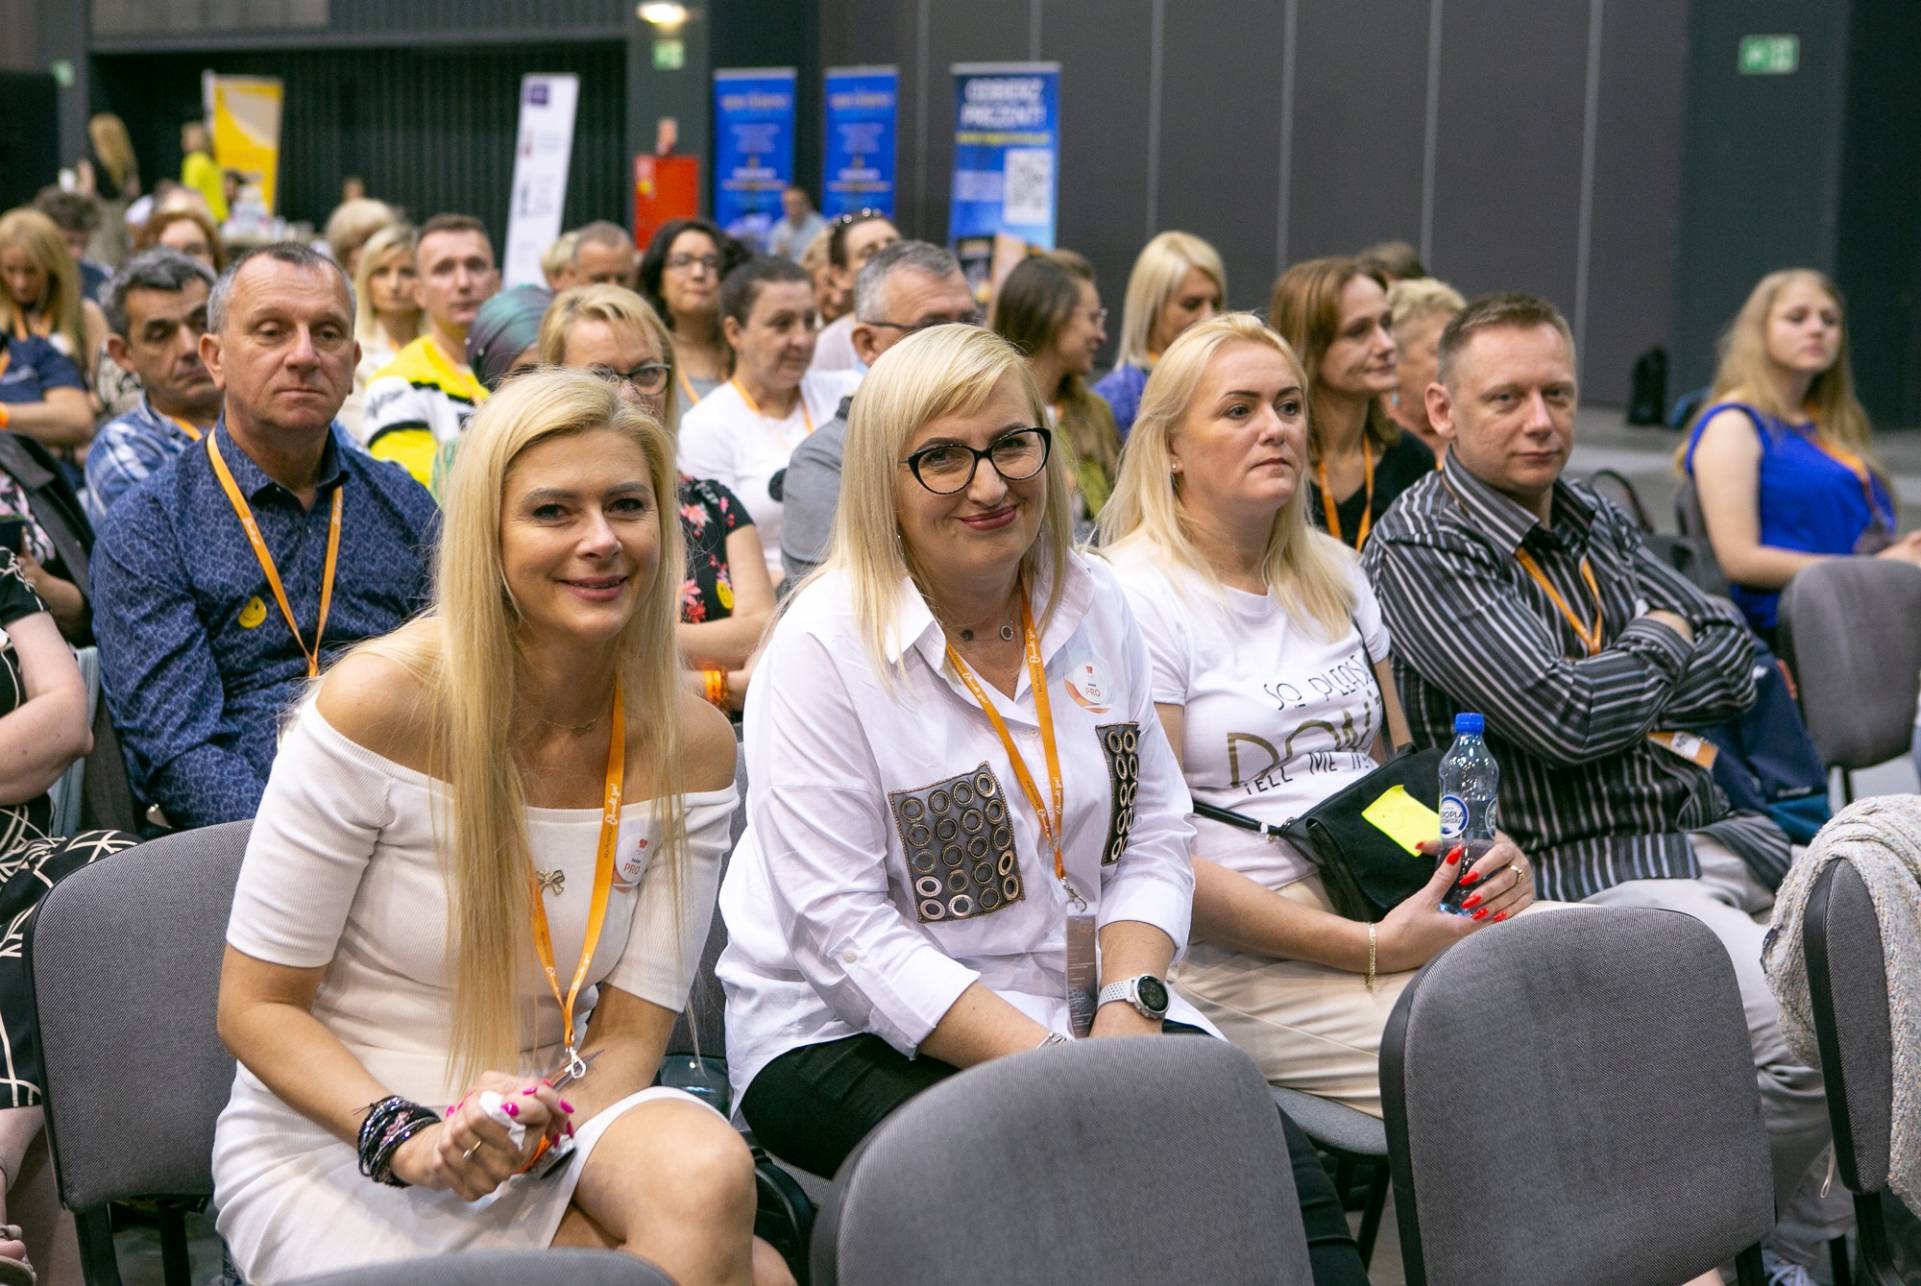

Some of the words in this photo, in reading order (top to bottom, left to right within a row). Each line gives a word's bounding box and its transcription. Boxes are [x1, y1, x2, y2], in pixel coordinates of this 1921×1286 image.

[1263, 682, 1306, 711] SO
[1308, 654, 1374, 702] PLEAS
[1244, 766, 1293, 796] TELL
[1309, 752, 1338, 775] ME
[623, 862, 641, 875] PRO
